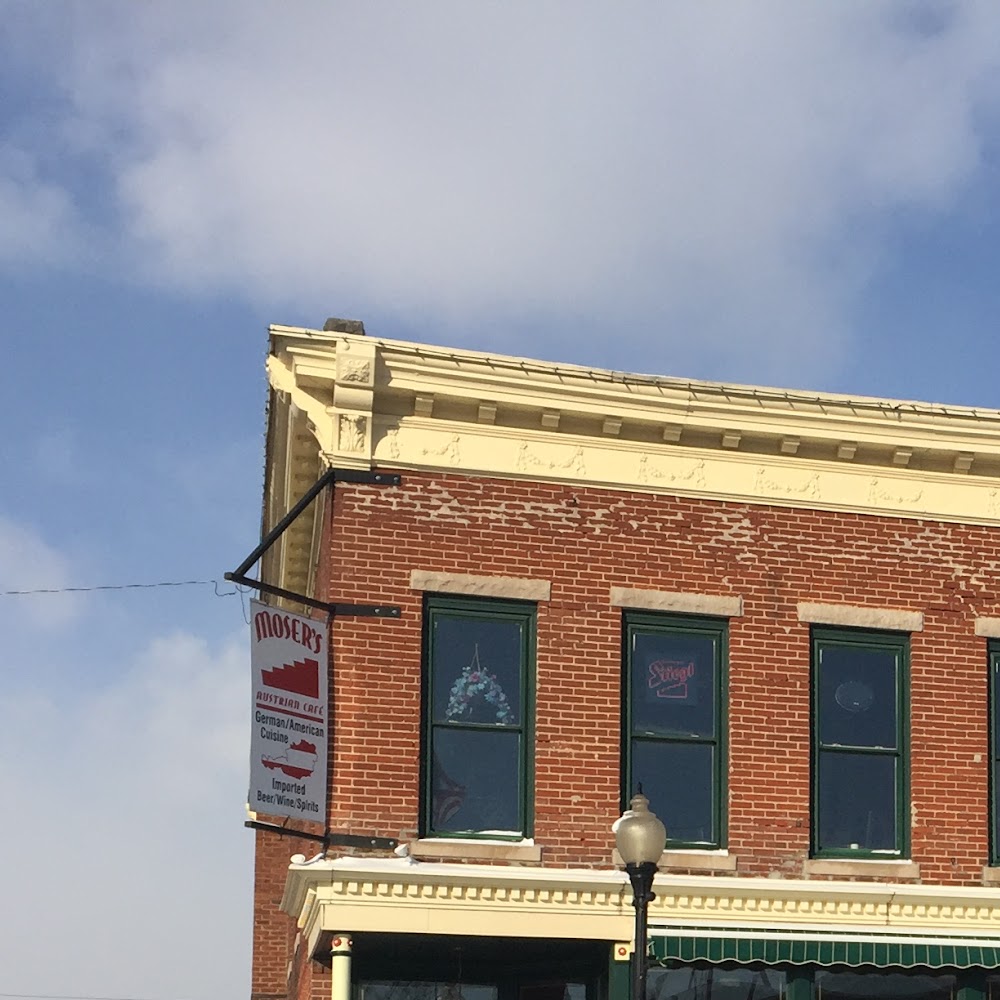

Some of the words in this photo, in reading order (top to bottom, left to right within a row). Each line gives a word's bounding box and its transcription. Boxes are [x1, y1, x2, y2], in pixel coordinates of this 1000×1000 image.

[255, 611, 322, 654] MOSER'S
[256, 691, 299, 710] AUSTRIAN
[256, 710, 325, 738] German/American
[260, 727, 289, 744] Cuisine
[272, 777, 306, 795] Imported
[257, 790, 319, 812] Beer/Wine/Spirits
